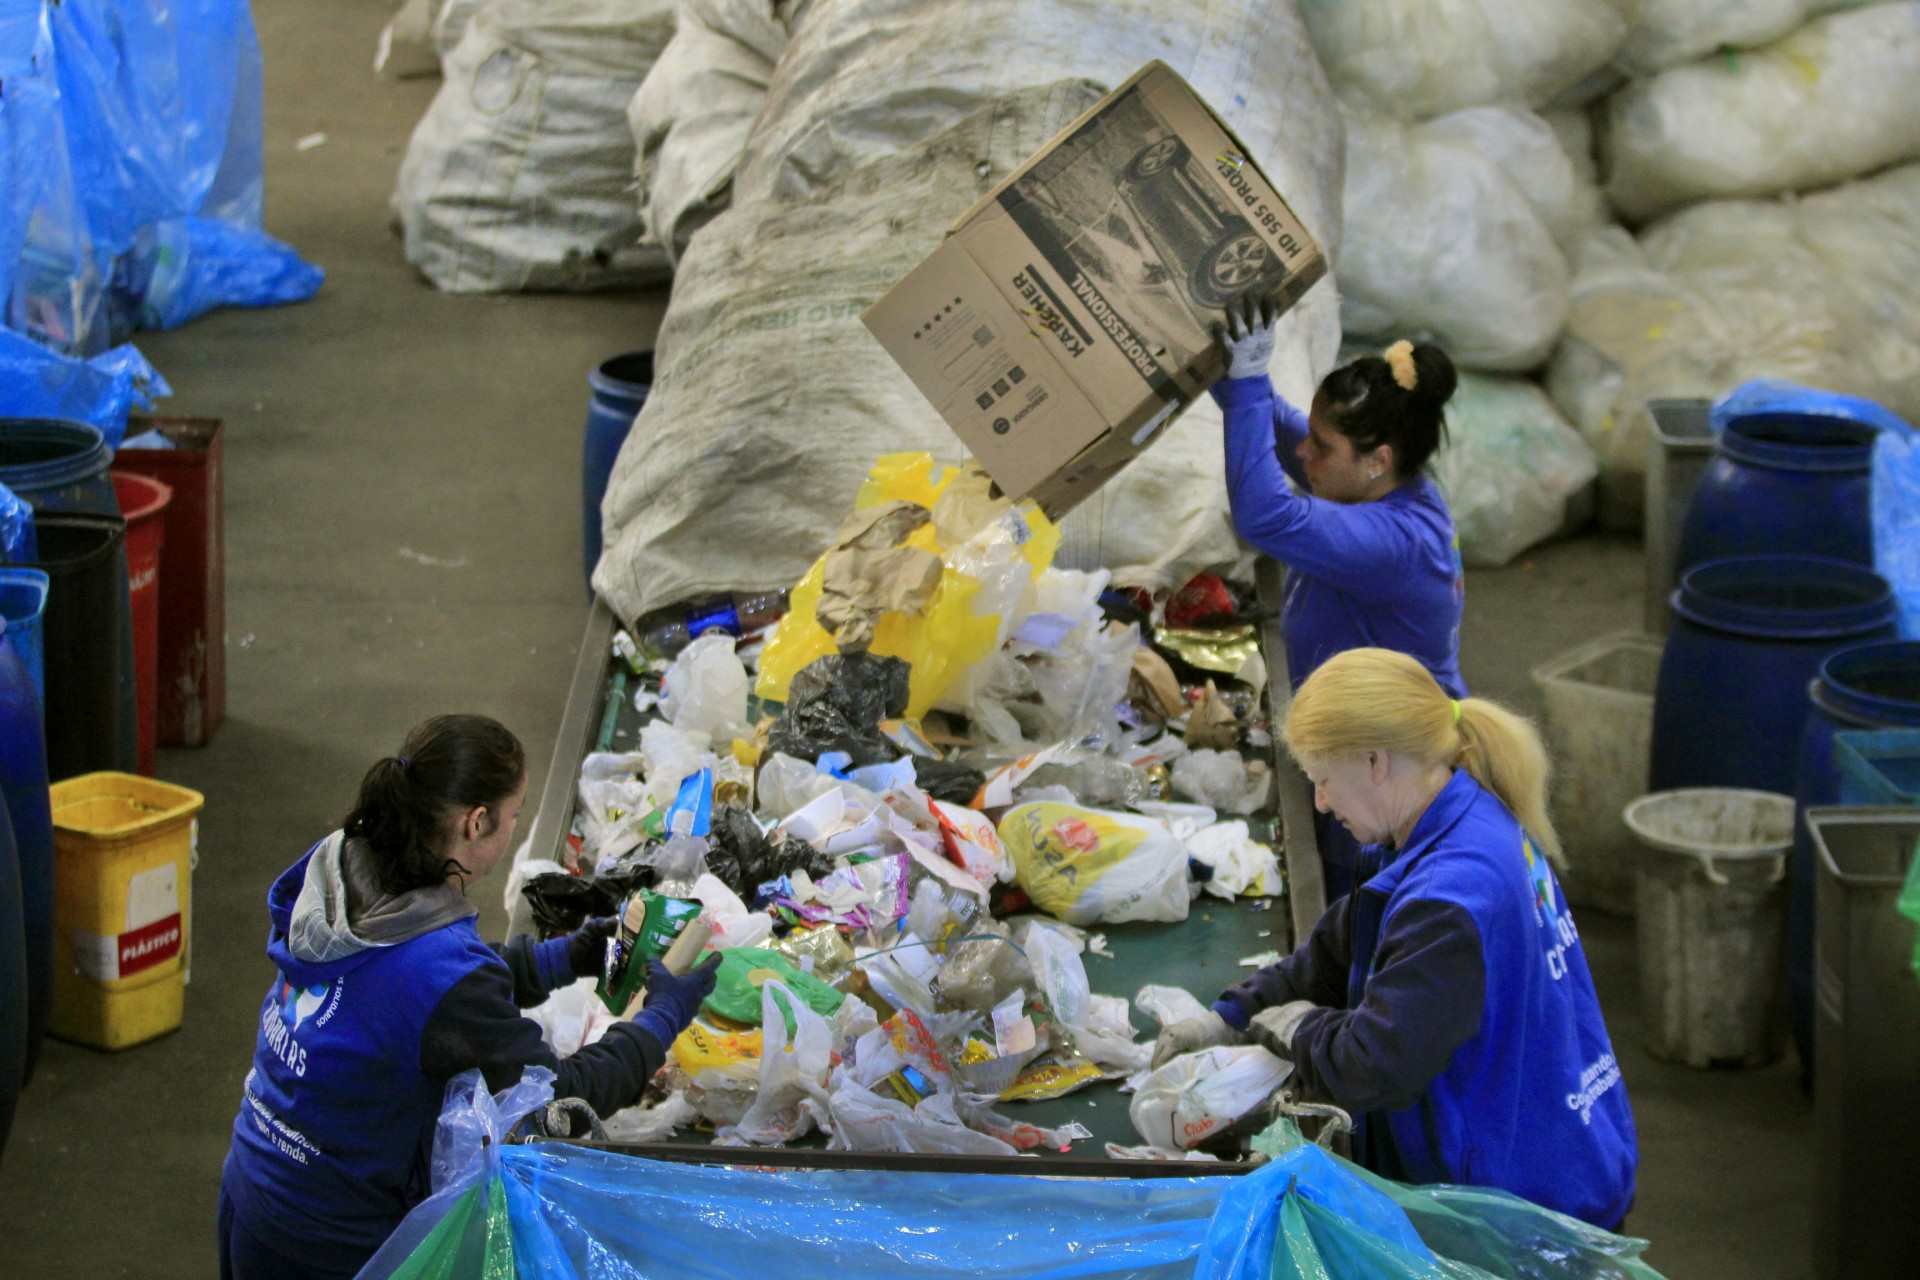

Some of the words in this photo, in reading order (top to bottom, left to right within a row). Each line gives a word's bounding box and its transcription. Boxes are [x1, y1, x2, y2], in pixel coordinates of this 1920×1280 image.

[1252, 203, 1283, 236] 585
[1276, 231, 1302, 258] HD
[1068, 271, 1158, 377] PROFESSIONAL
[277, 1136, 310, 1167] renda.
